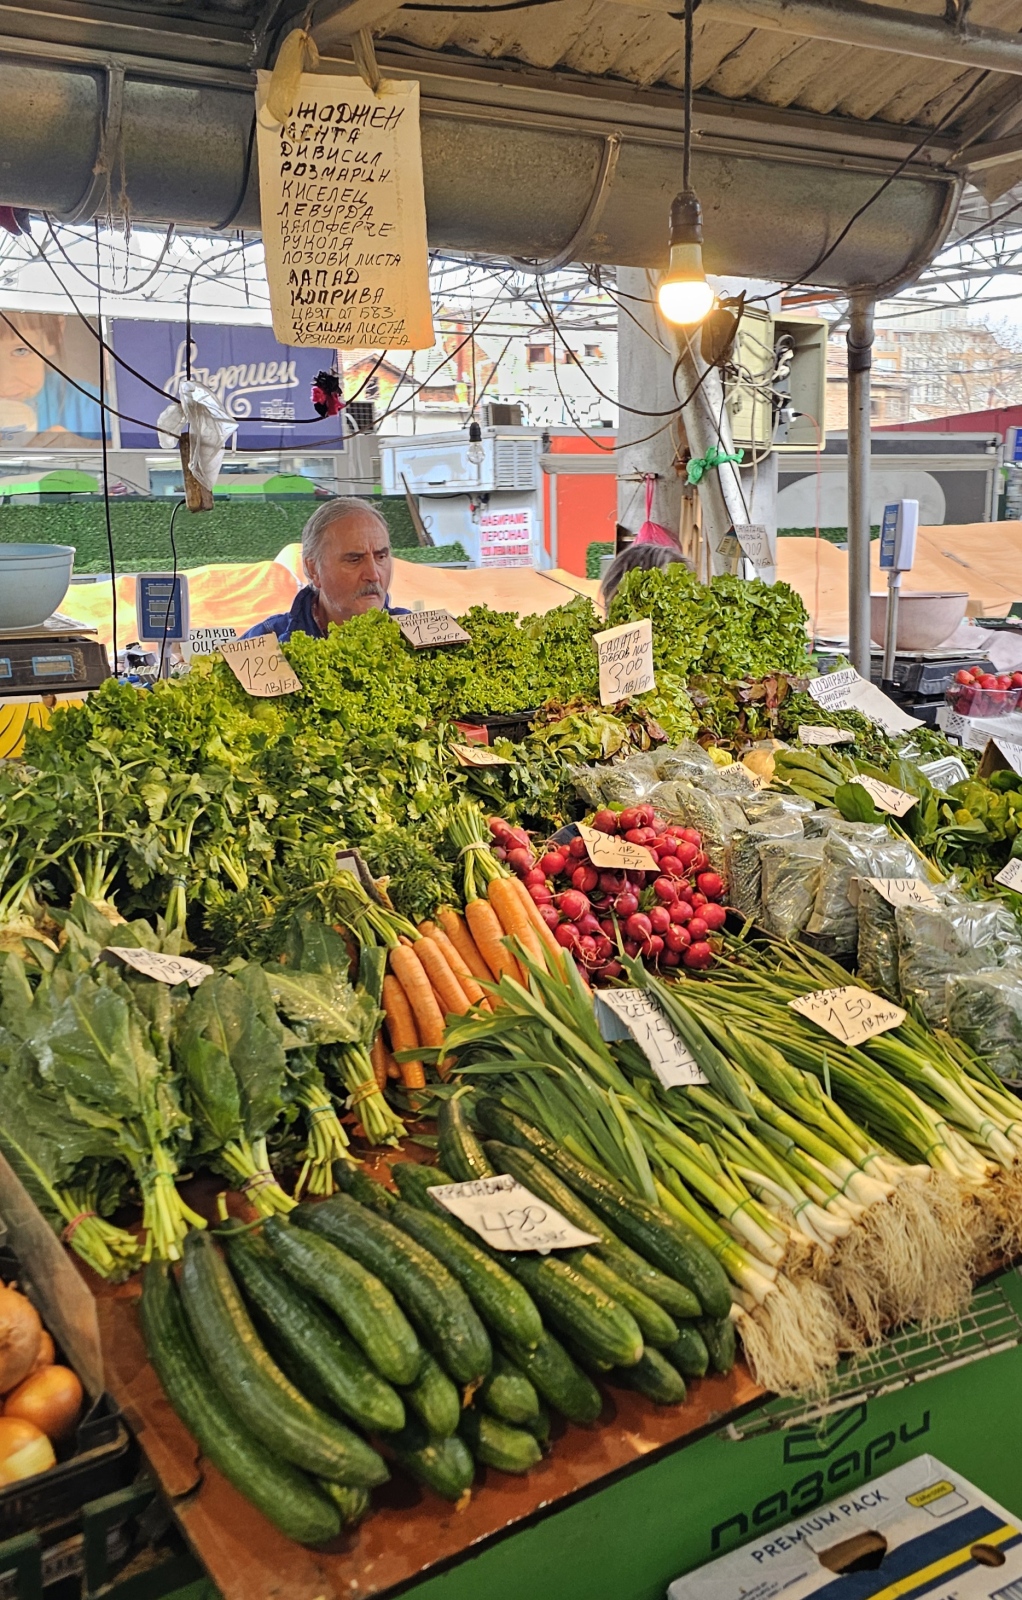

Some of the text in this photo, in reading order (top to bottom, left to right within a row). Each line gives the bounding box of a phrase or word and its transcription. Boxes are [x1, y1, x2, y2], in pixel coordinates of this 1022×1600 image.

[288, 101, 405, 130] ЖОДЖЕН
[279, 121, 362, 145] МЕНТА
[280, 140, 382, 167] ДИВИСИЛ
[280, 160, 391, 183] РОЗМАРИН
[281, 180, 368, 209] КИСЕЛЕЦ
[276, 201, 374, 224] ЛЕВУРДА
[282, 234, 354, 251] РУКОЛЯ
[282, 250, 401, 267] ЛОЗОВИ ЛИСТА
[287, 267, 360, 288] ЛАПАД
[290, 286, 385, 306] КОПРИВА
[291, 306, 336, 323] ЦВЯТ
[338, 306, 357, 320] ОТ
[292, 319, 406, 336] ЦЕЛИНА ЛИСТА
[293, 331, 411, 346] ХРЯНОВИ ЛИСТА
[189, 628, 237, 641] БЪЛКОВ
[599, 629, 641, 656] САЛАТА
[219, 636, 267, 654] САЛАТА
[600, 646, 630, 666] ДЪБОВ
[751, 1488, 889, 1564] PREMIUM PACK
